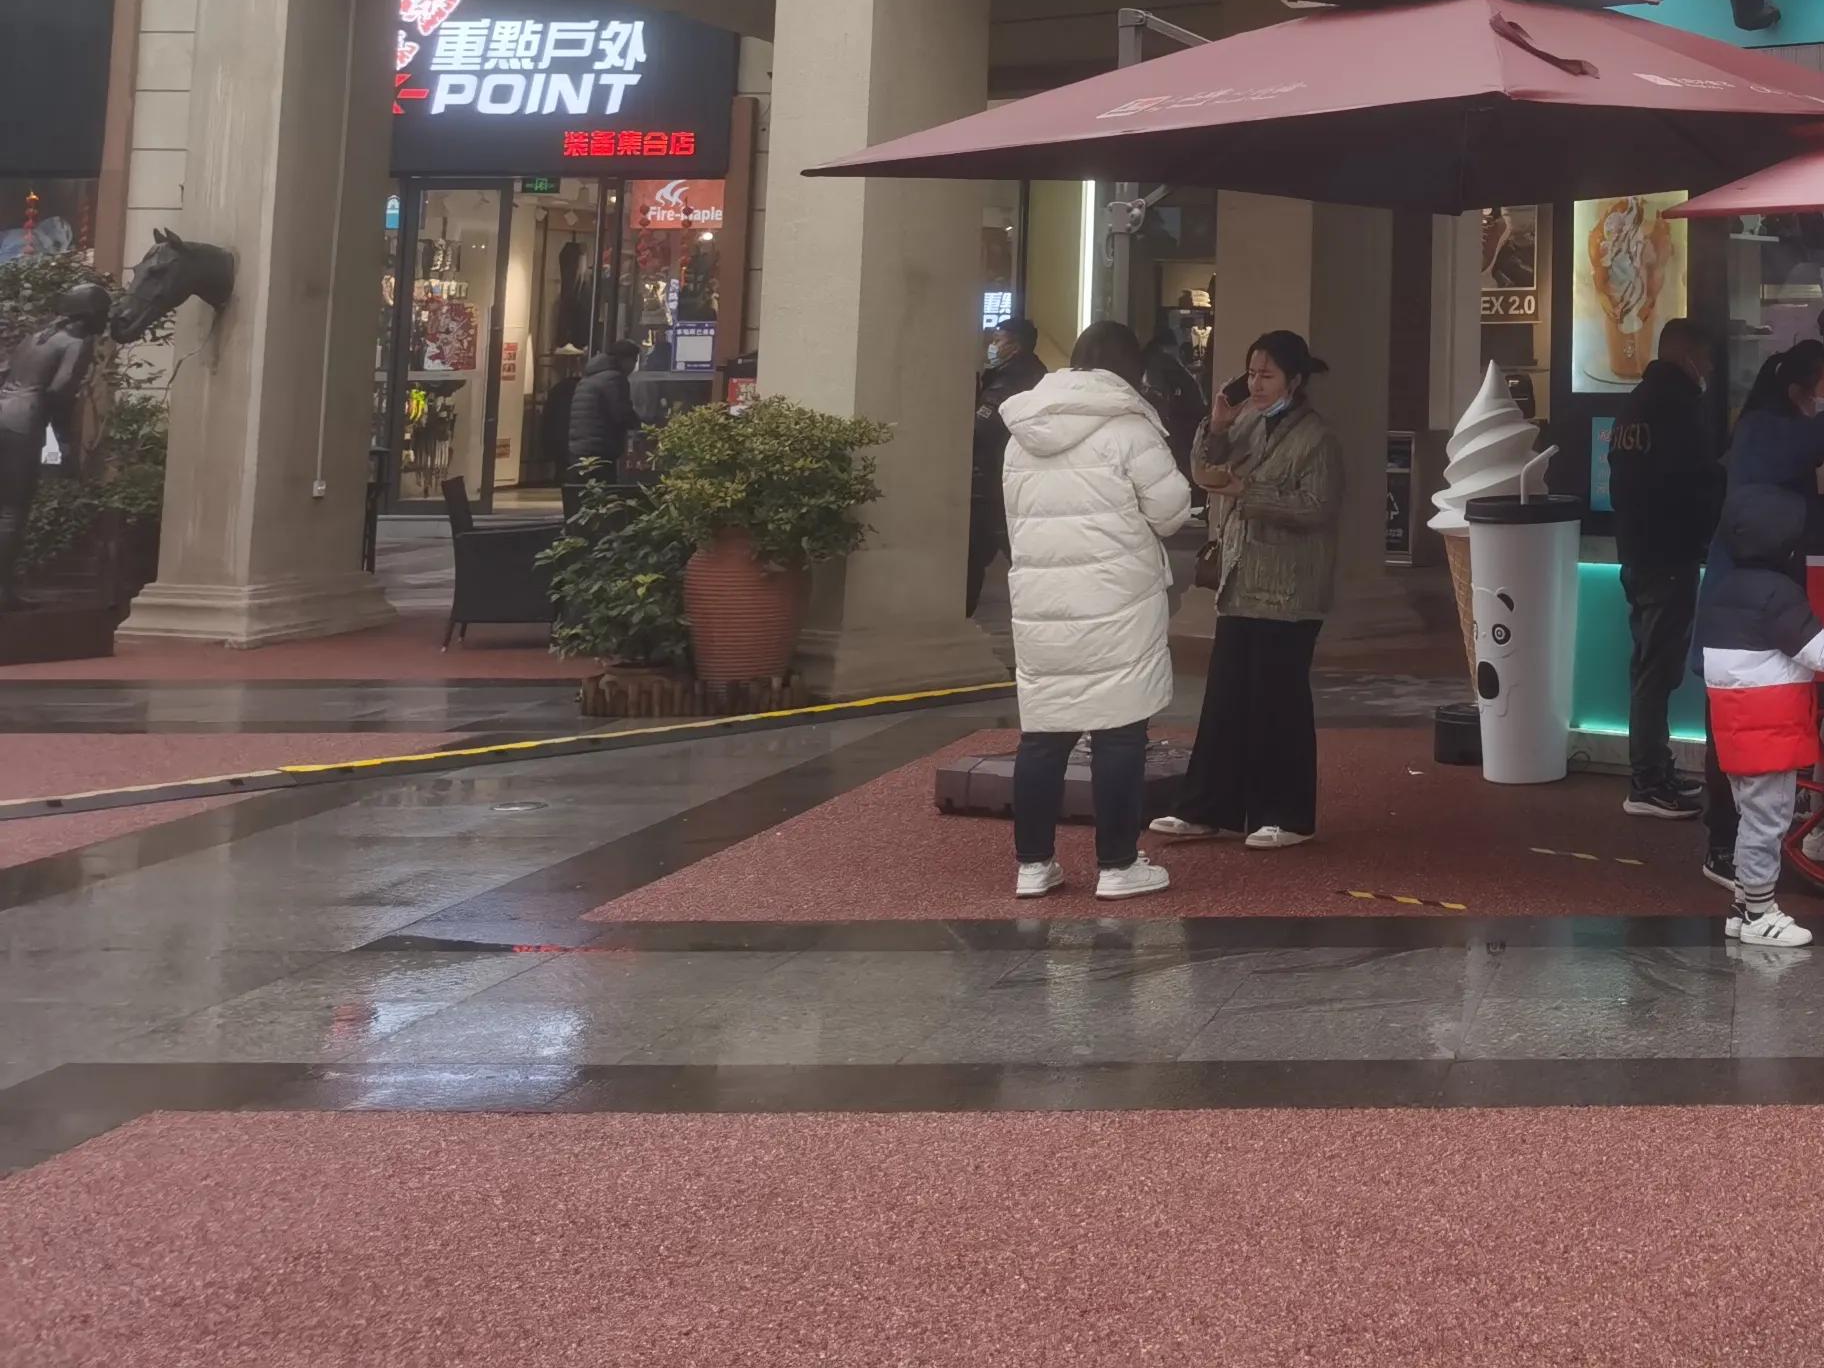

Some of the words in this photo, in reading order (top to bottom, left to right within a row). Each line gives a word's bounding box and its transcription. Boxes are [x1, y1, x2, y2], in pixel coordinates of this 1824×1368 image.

[562, 131, 696, 157] 装备集合店
[1508, 295, 1536, 315] 2.0
